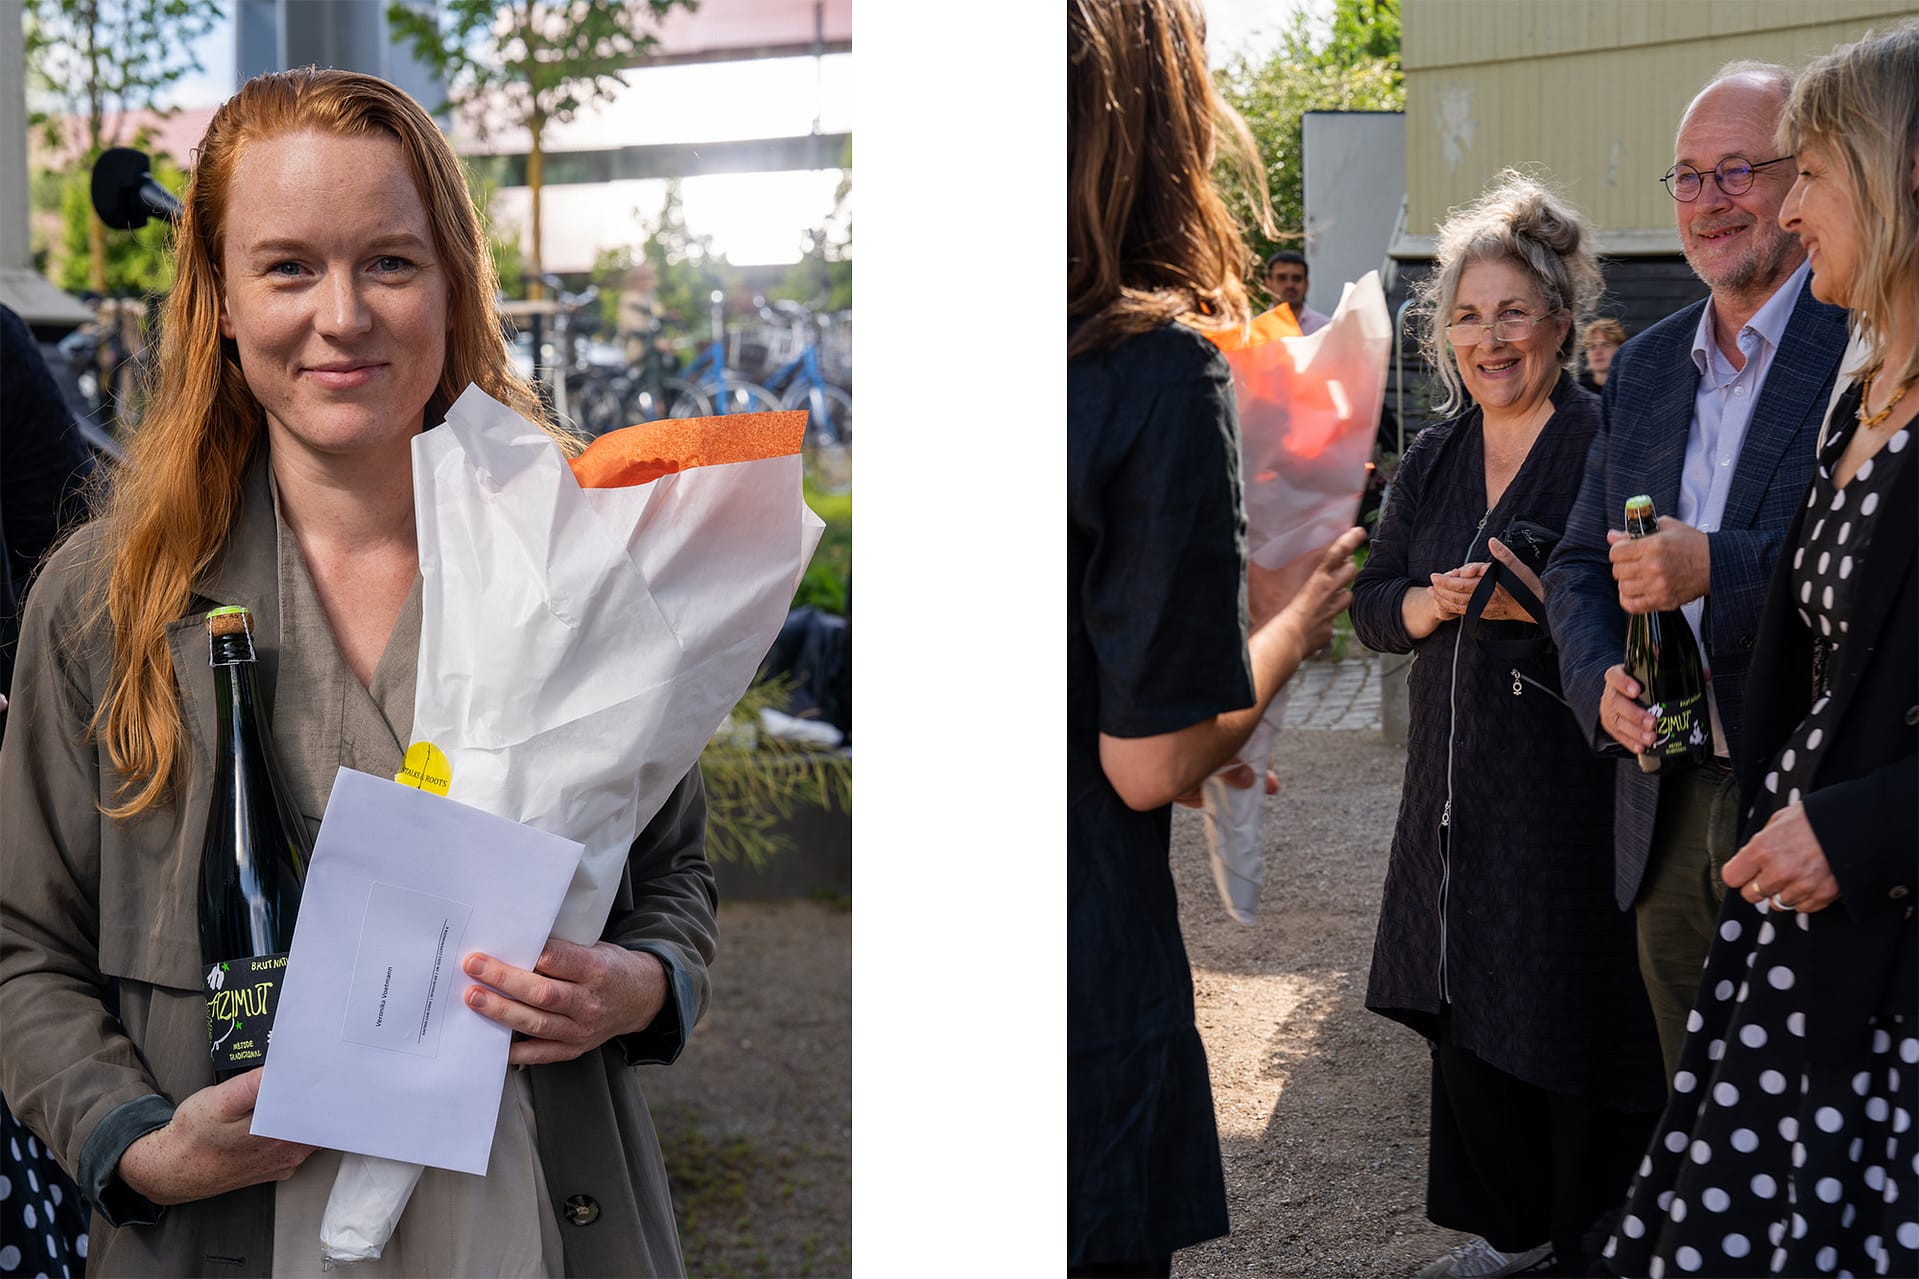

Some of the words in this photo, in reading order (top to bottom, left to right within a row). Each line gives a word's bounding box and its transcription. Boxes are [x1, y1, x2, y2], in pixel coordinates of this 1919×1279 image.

[1656, 709, 1691, 735] ZIMUT
[424, 775, 448, 788] ROOTS
[251, 959, 272, 971] BRUT
[207, 982, 273, 1021] AZIMUT
[376, 1000, 386, 1027] Veronika
[381, 966, 392, 999] Voetmann
